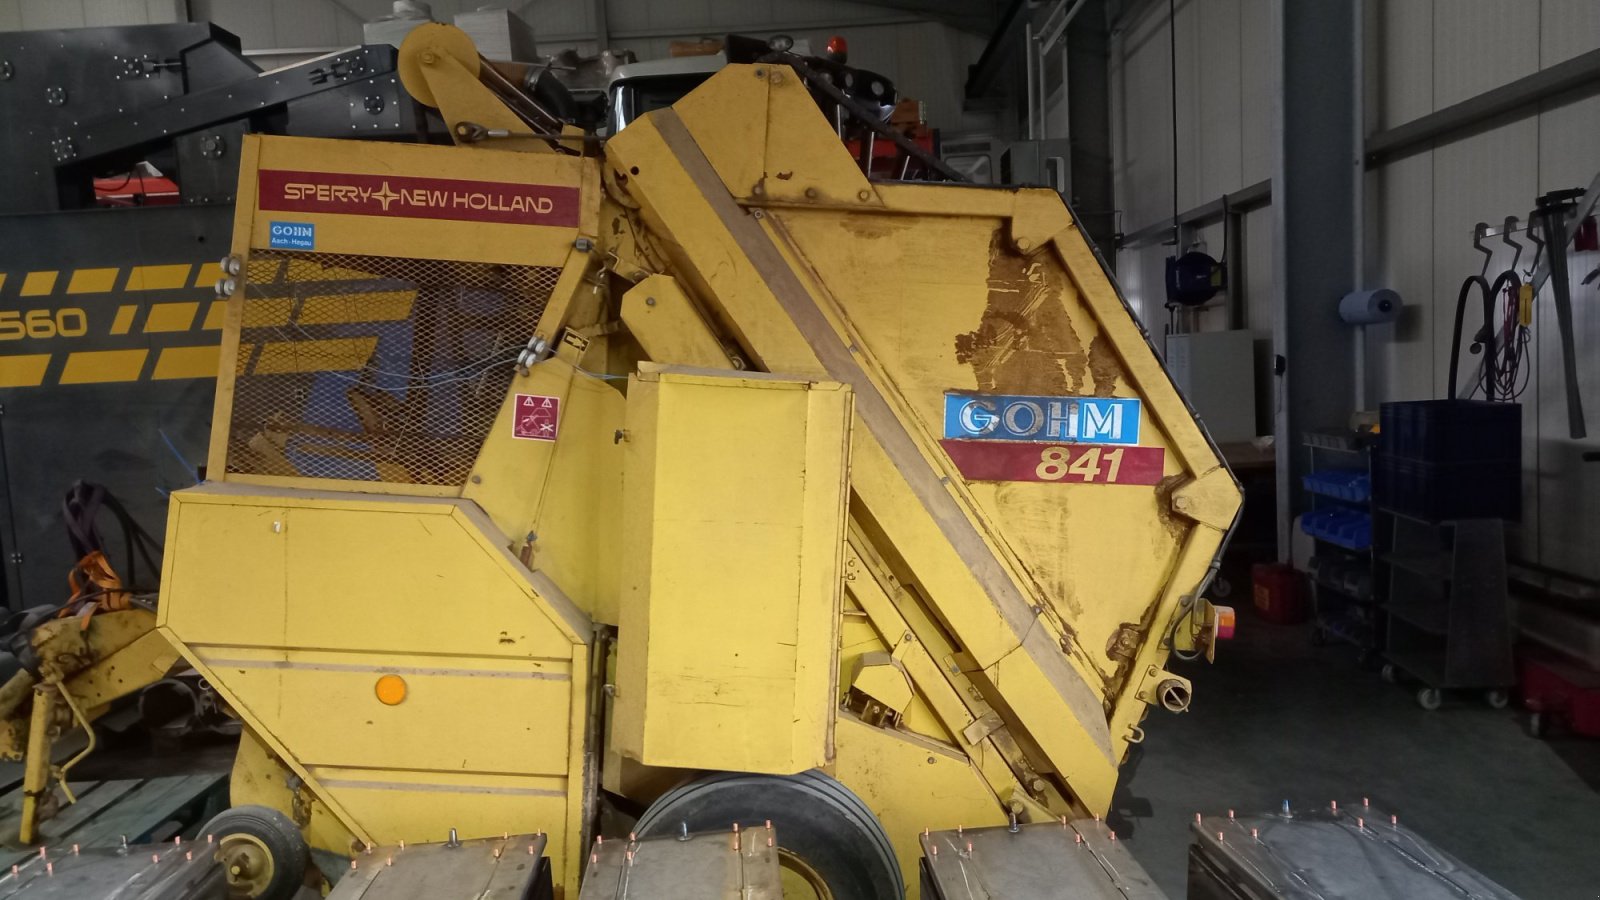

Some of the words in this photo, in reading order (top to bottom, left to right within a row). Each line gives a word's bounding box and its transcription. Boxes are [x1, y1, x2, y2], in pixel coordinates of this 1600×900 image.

[284, 183, 371, 203] SPERRY
[401, 189, 448, 208] NEW
[453, 191, 554, 214] HOLLAND
[959, 399, 1124, 440] GOHM
[1035, 446, 1125, 483] 841
